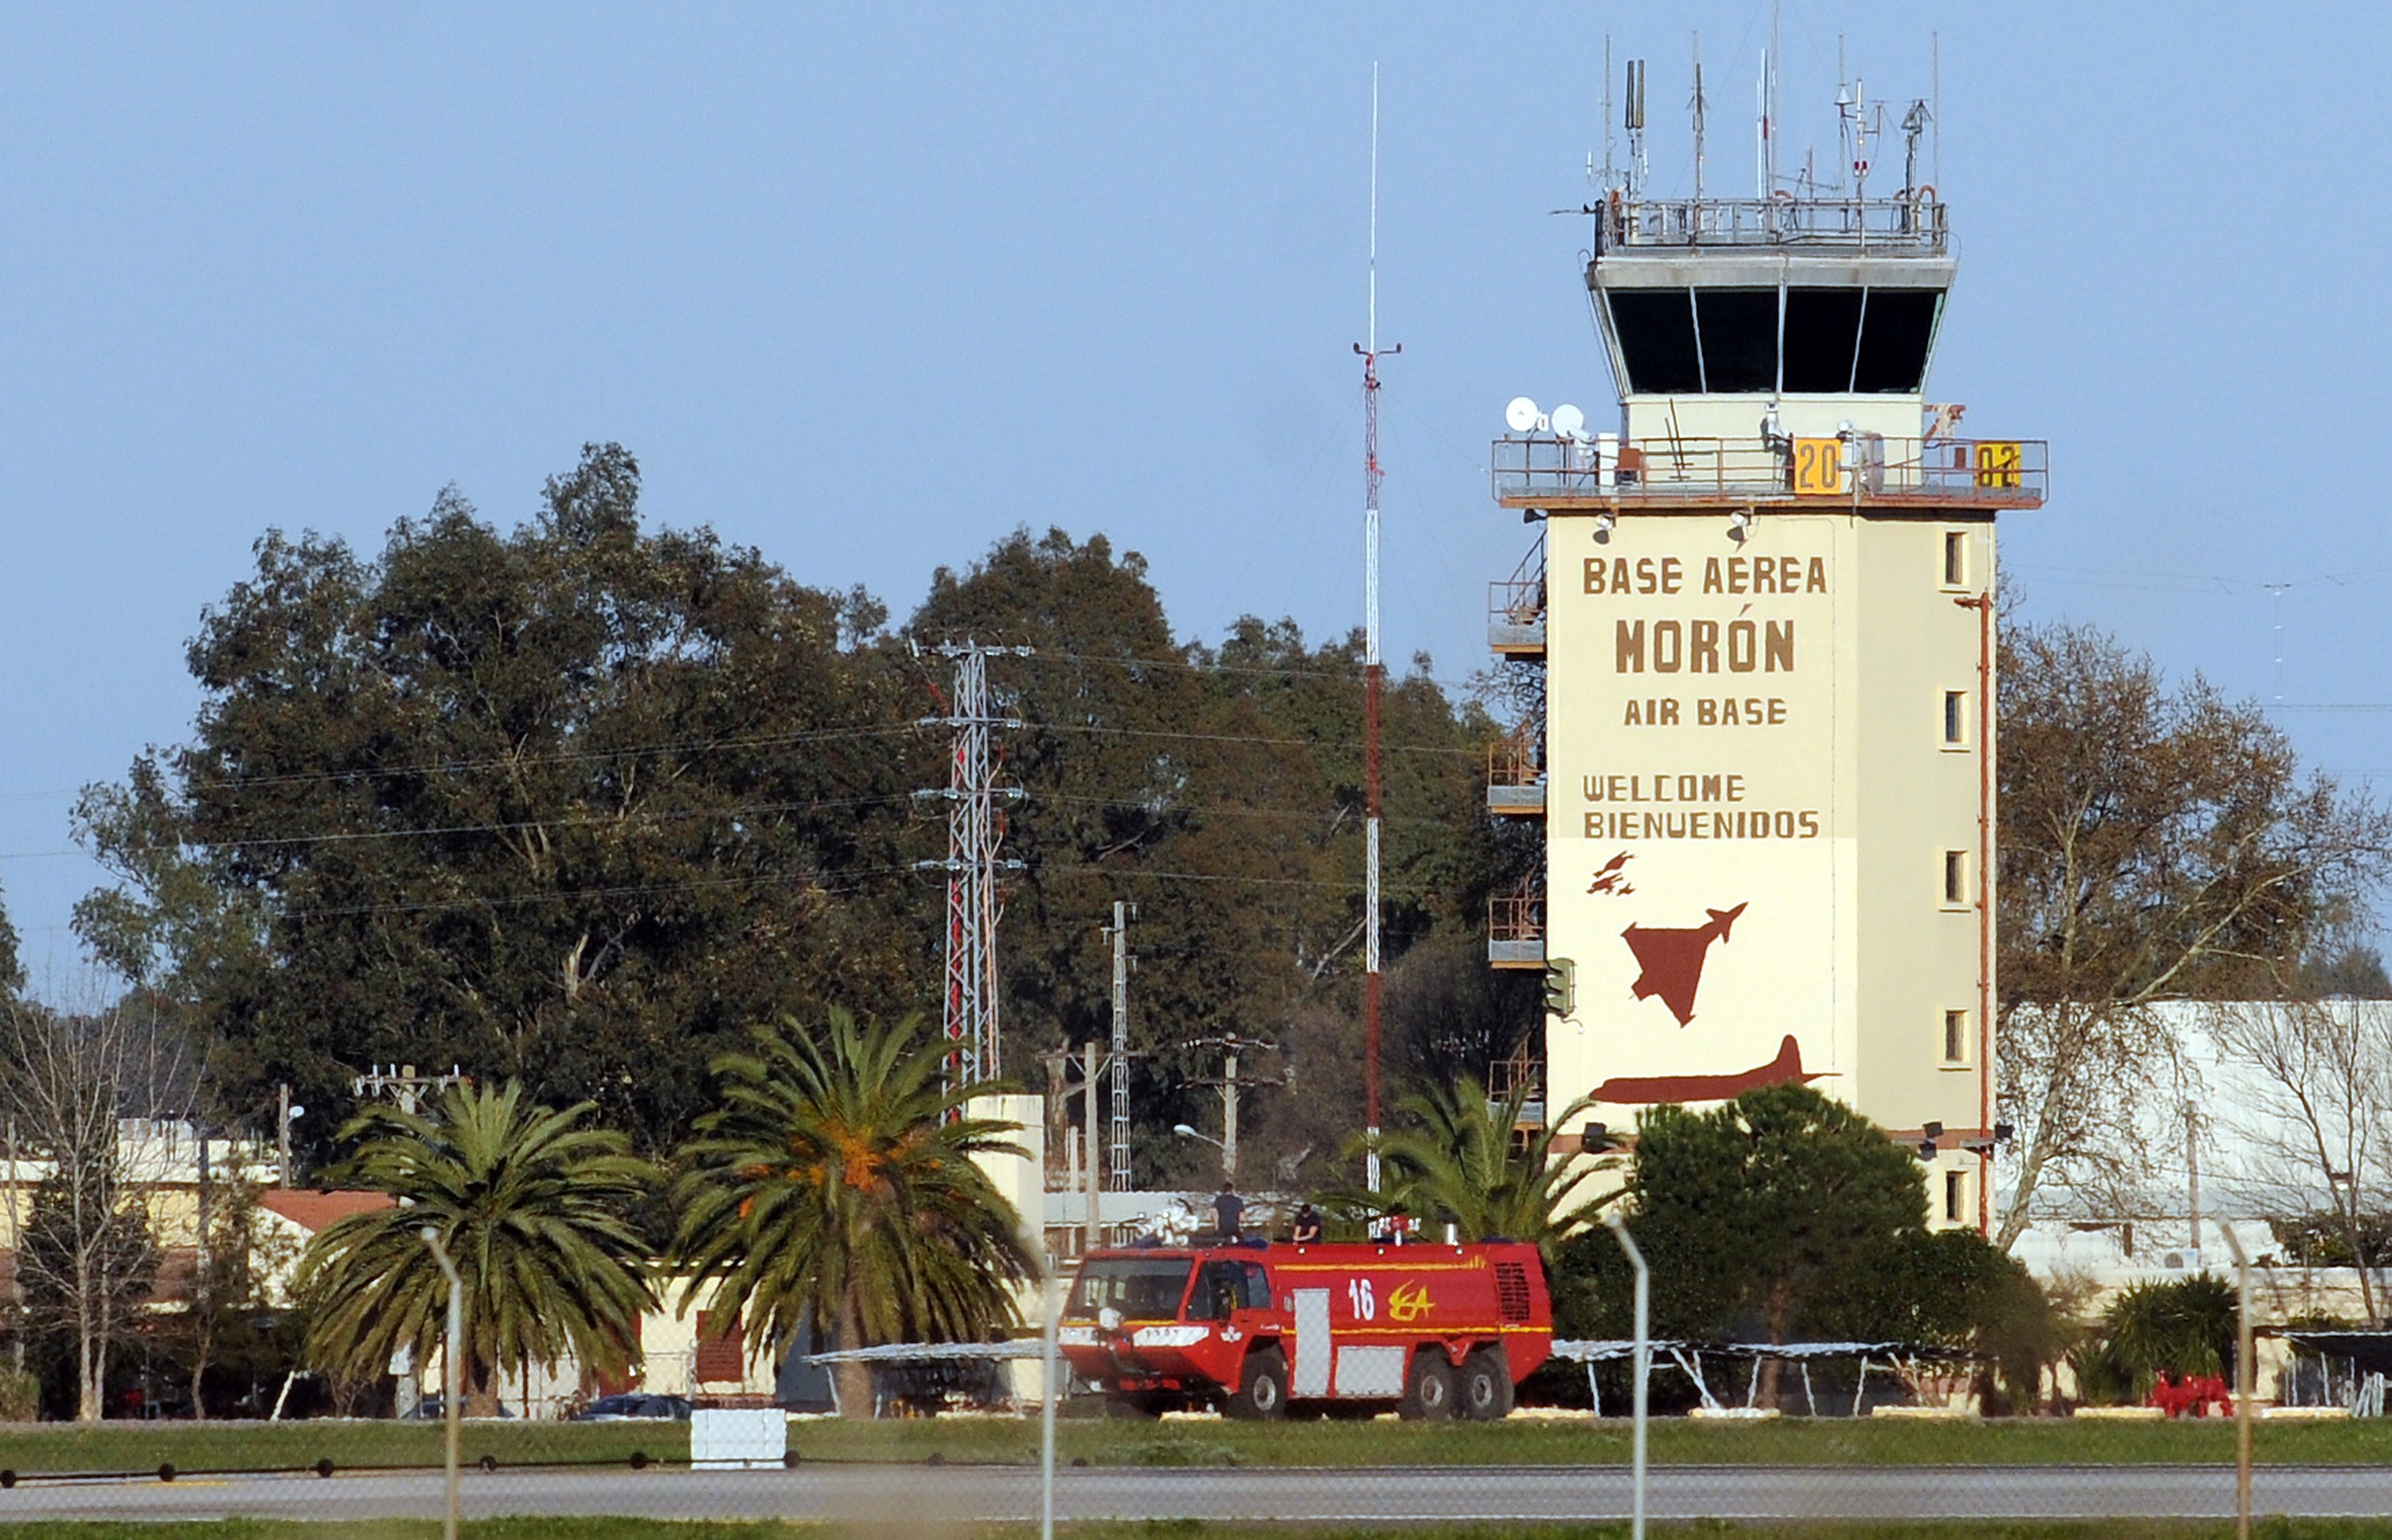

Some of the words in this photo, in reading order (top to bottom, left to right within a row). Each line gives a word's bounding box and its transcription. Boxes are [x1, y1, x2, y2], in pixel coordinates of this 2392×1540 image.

[1800, 444, 1835, 488] 20
[1584, 557, 1682, 595] BASE
[1616, 603, 1794, 674] MORÓN
[1624, 698, 1680, 726] AIR
[1698, 698, 1787, 726] BASE
[1584, 775, 1745, 803] WELCOME
[1348, 1279, 1375, 1321] 16
